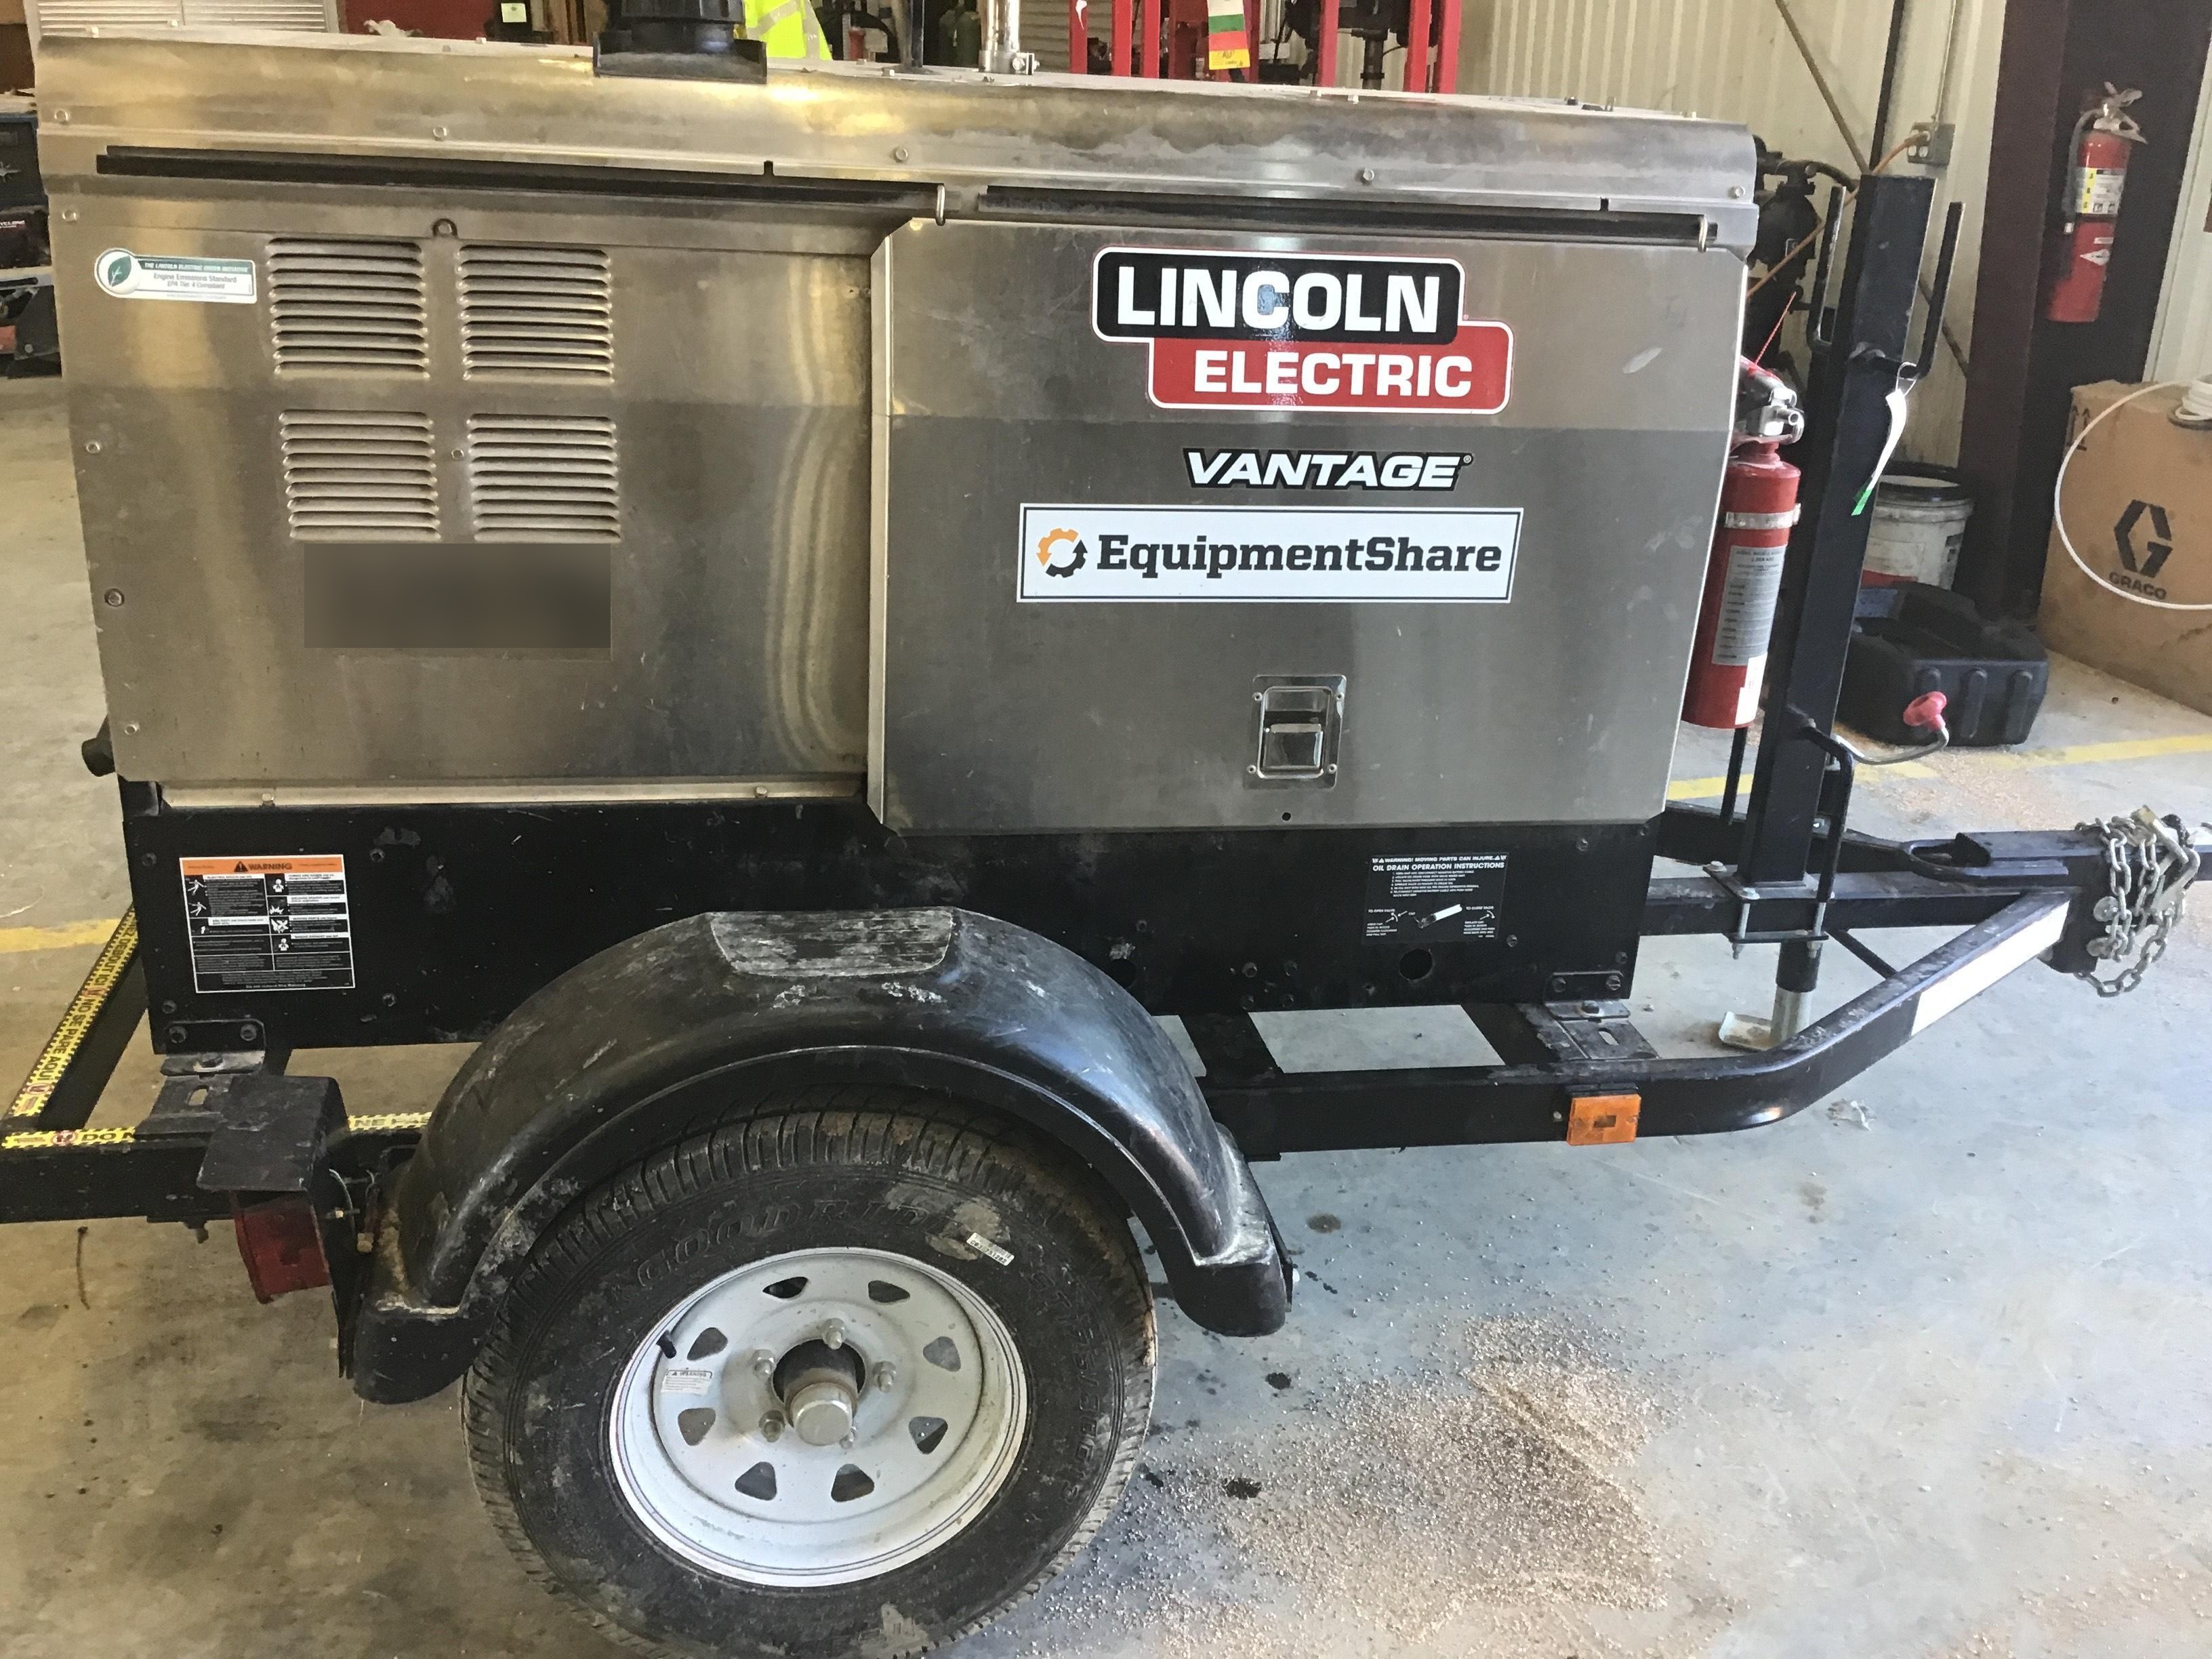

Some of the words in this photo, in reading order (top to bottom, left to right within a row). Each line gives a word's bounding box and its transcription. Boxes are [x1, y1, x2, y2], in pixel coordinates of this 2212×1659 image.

[1118, 266, 1440, 333] LINCOLN
[1193, 350, 1473, 398] ELECTRIC
[1187, 452, 1461, 489] VANTAGE
[1097, 534, 1502, 579] EquipmentShare
[2109, 572, 2167, 600] GRACO
[77, 998, 96, 1012] NO
[68, 1015, 86, 1027] SE
[53, 1029, 79, 1054] PARE
[354, 1118, 386, 1127] NE
[81, 1133, 117, 1141] DO
